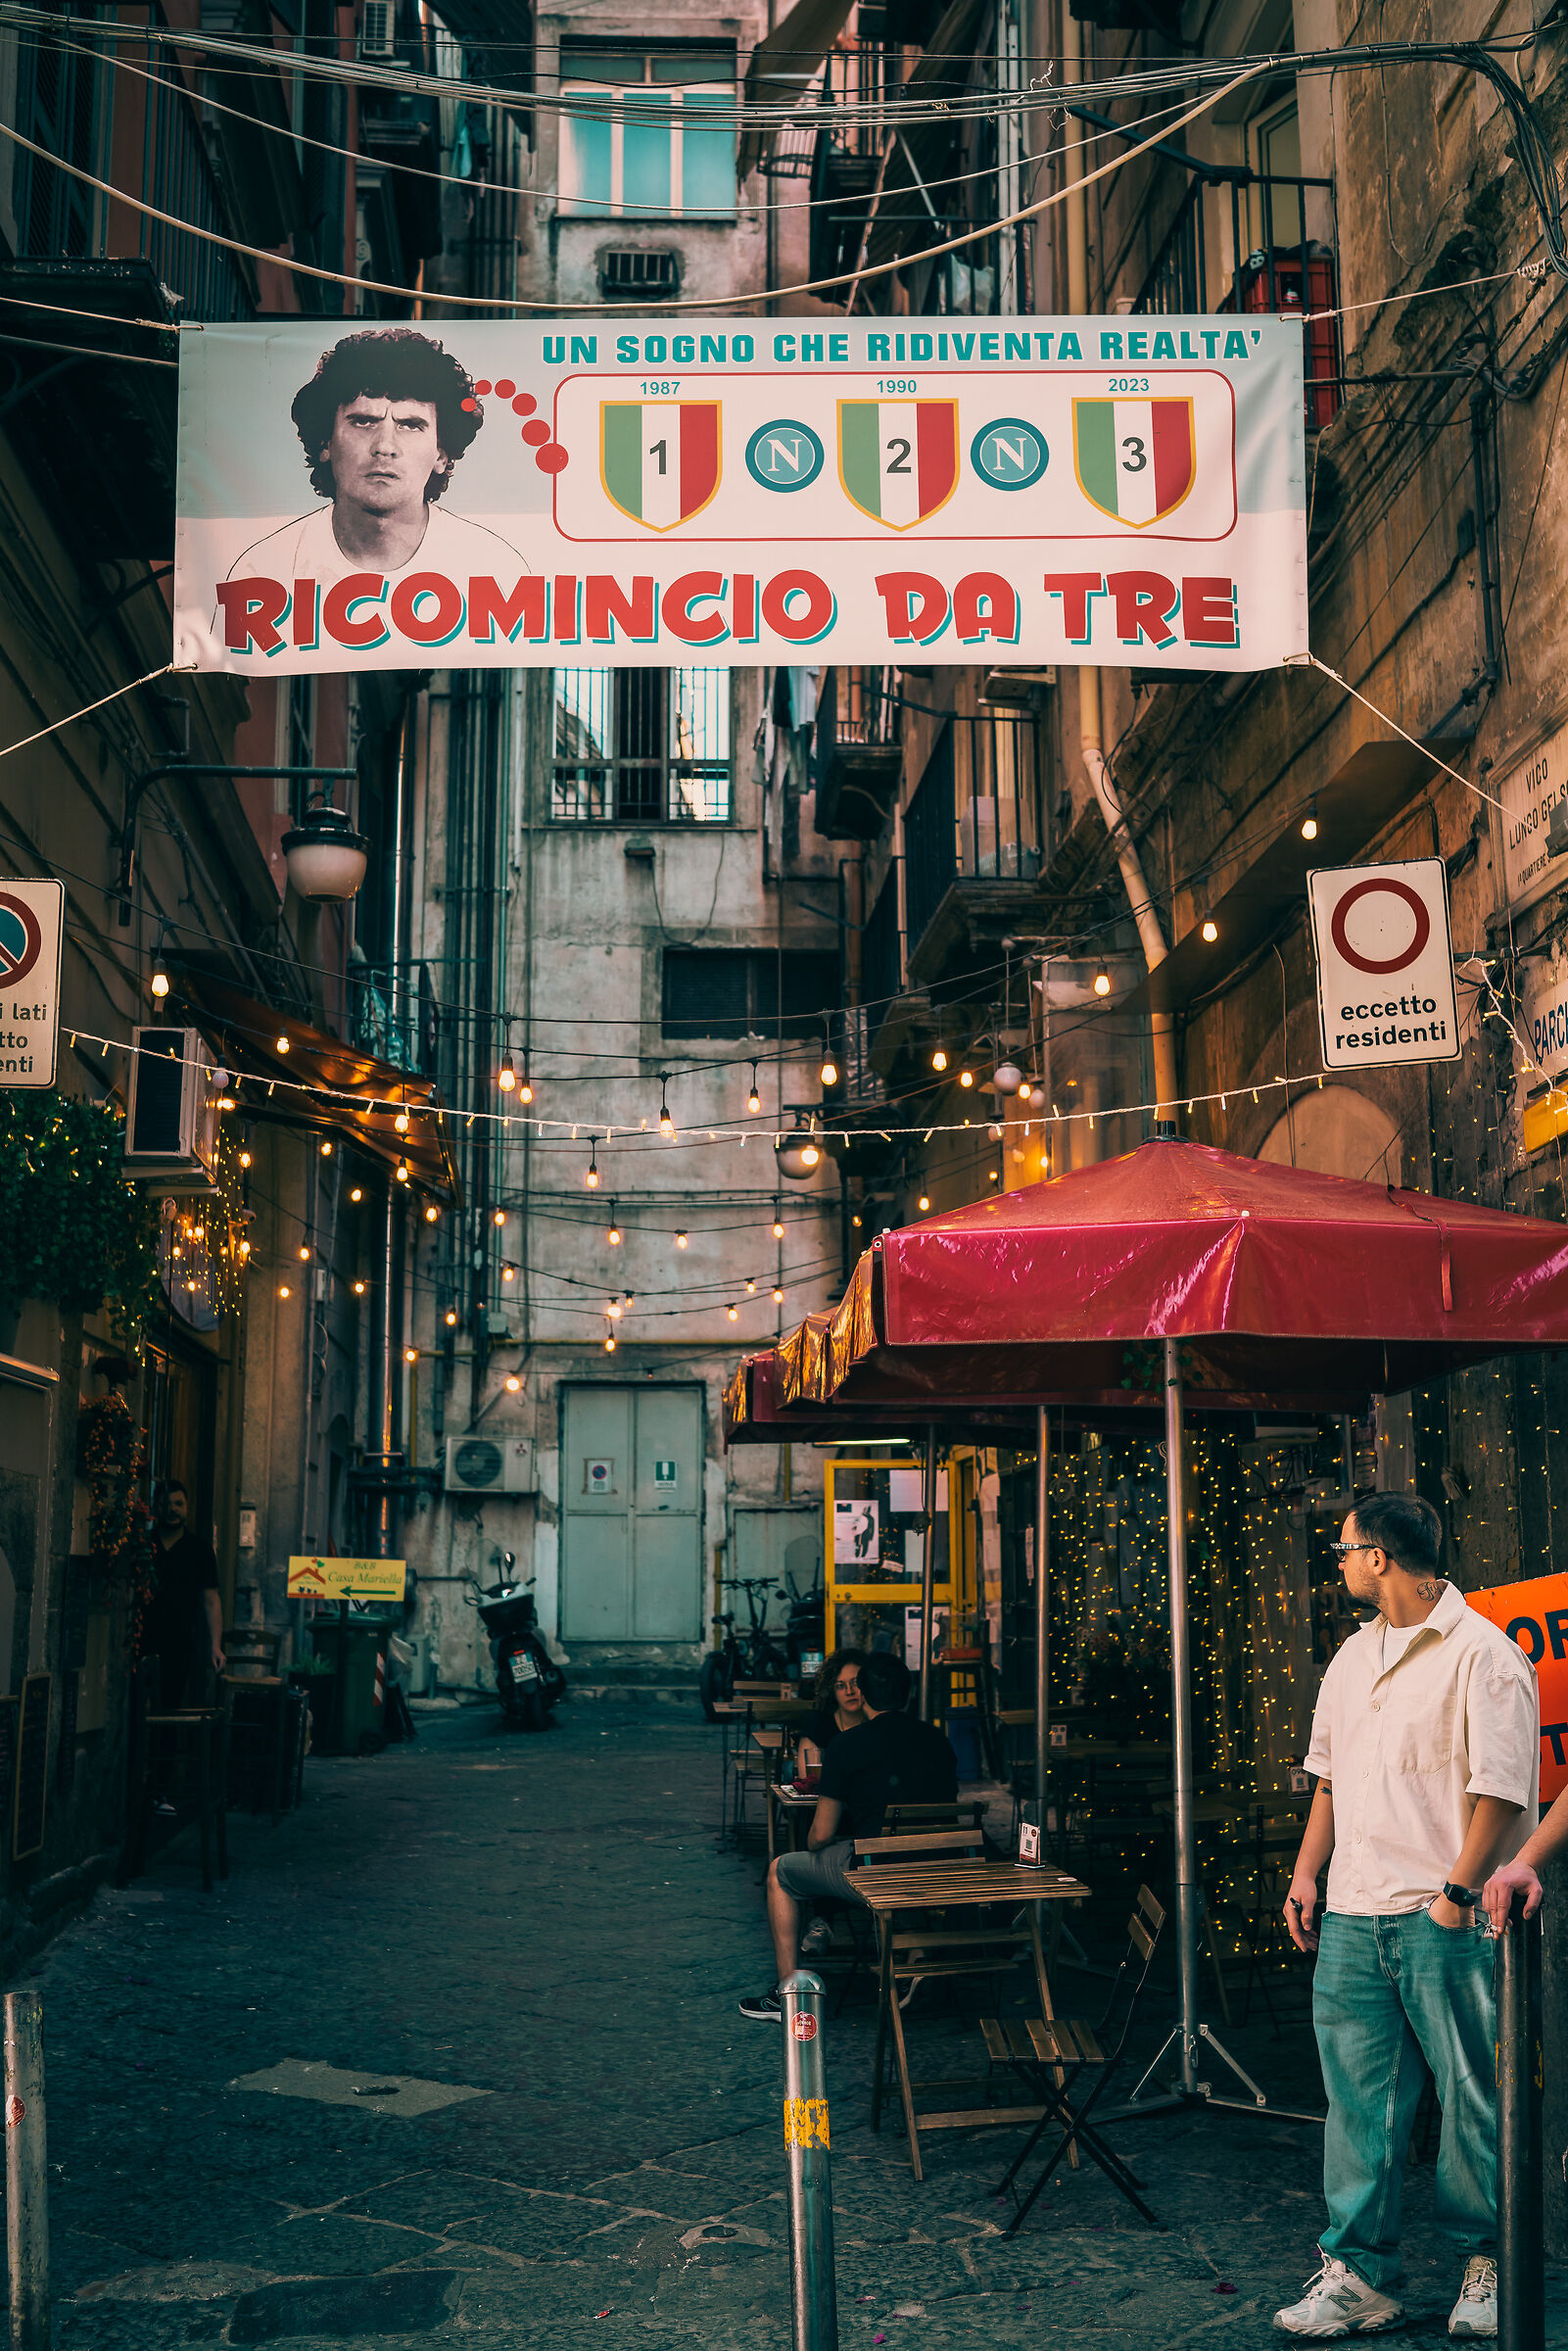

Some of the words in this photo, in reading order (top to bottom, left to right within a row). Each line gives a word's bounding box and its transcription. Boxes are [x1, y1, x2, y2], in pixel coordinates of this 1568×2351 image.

[542, 335, 598, 364] UN
[615, 334, 755, 364] SOGNO
[773, 333, 849, 362] CHE
[867, 331, 1083, 362] RIDIVENTA
[1099, 329, 1261, 361] REALTA'
[640, 381, 681, 396] 1987
[877, 379, 918, 394] 1990
[1108, 377, 1150, 392] 2023
[649, 439, 667, 475] 1
[767, 439, 802, 472] N
[885, 438, 912, 473] 2
[991, 437, 1027, 471] N
[1121, 436, 1148, 472] 3
[215, 569, 838, 658] RICOMINCIO
[875, 571, 1021, 647] DA
[1043, 570, 1241, 650] TRE
[1526, 757, 1548, 794] VICO
[1509, 807, 1539, 850] LUNGO
[13, 1003, 47, 1021] lati
[1340, 995, 1437, 1021] eccetto
[1335, 1021, 1447, 1049] residenti
[1328, 2284, 1363, 2312] N
